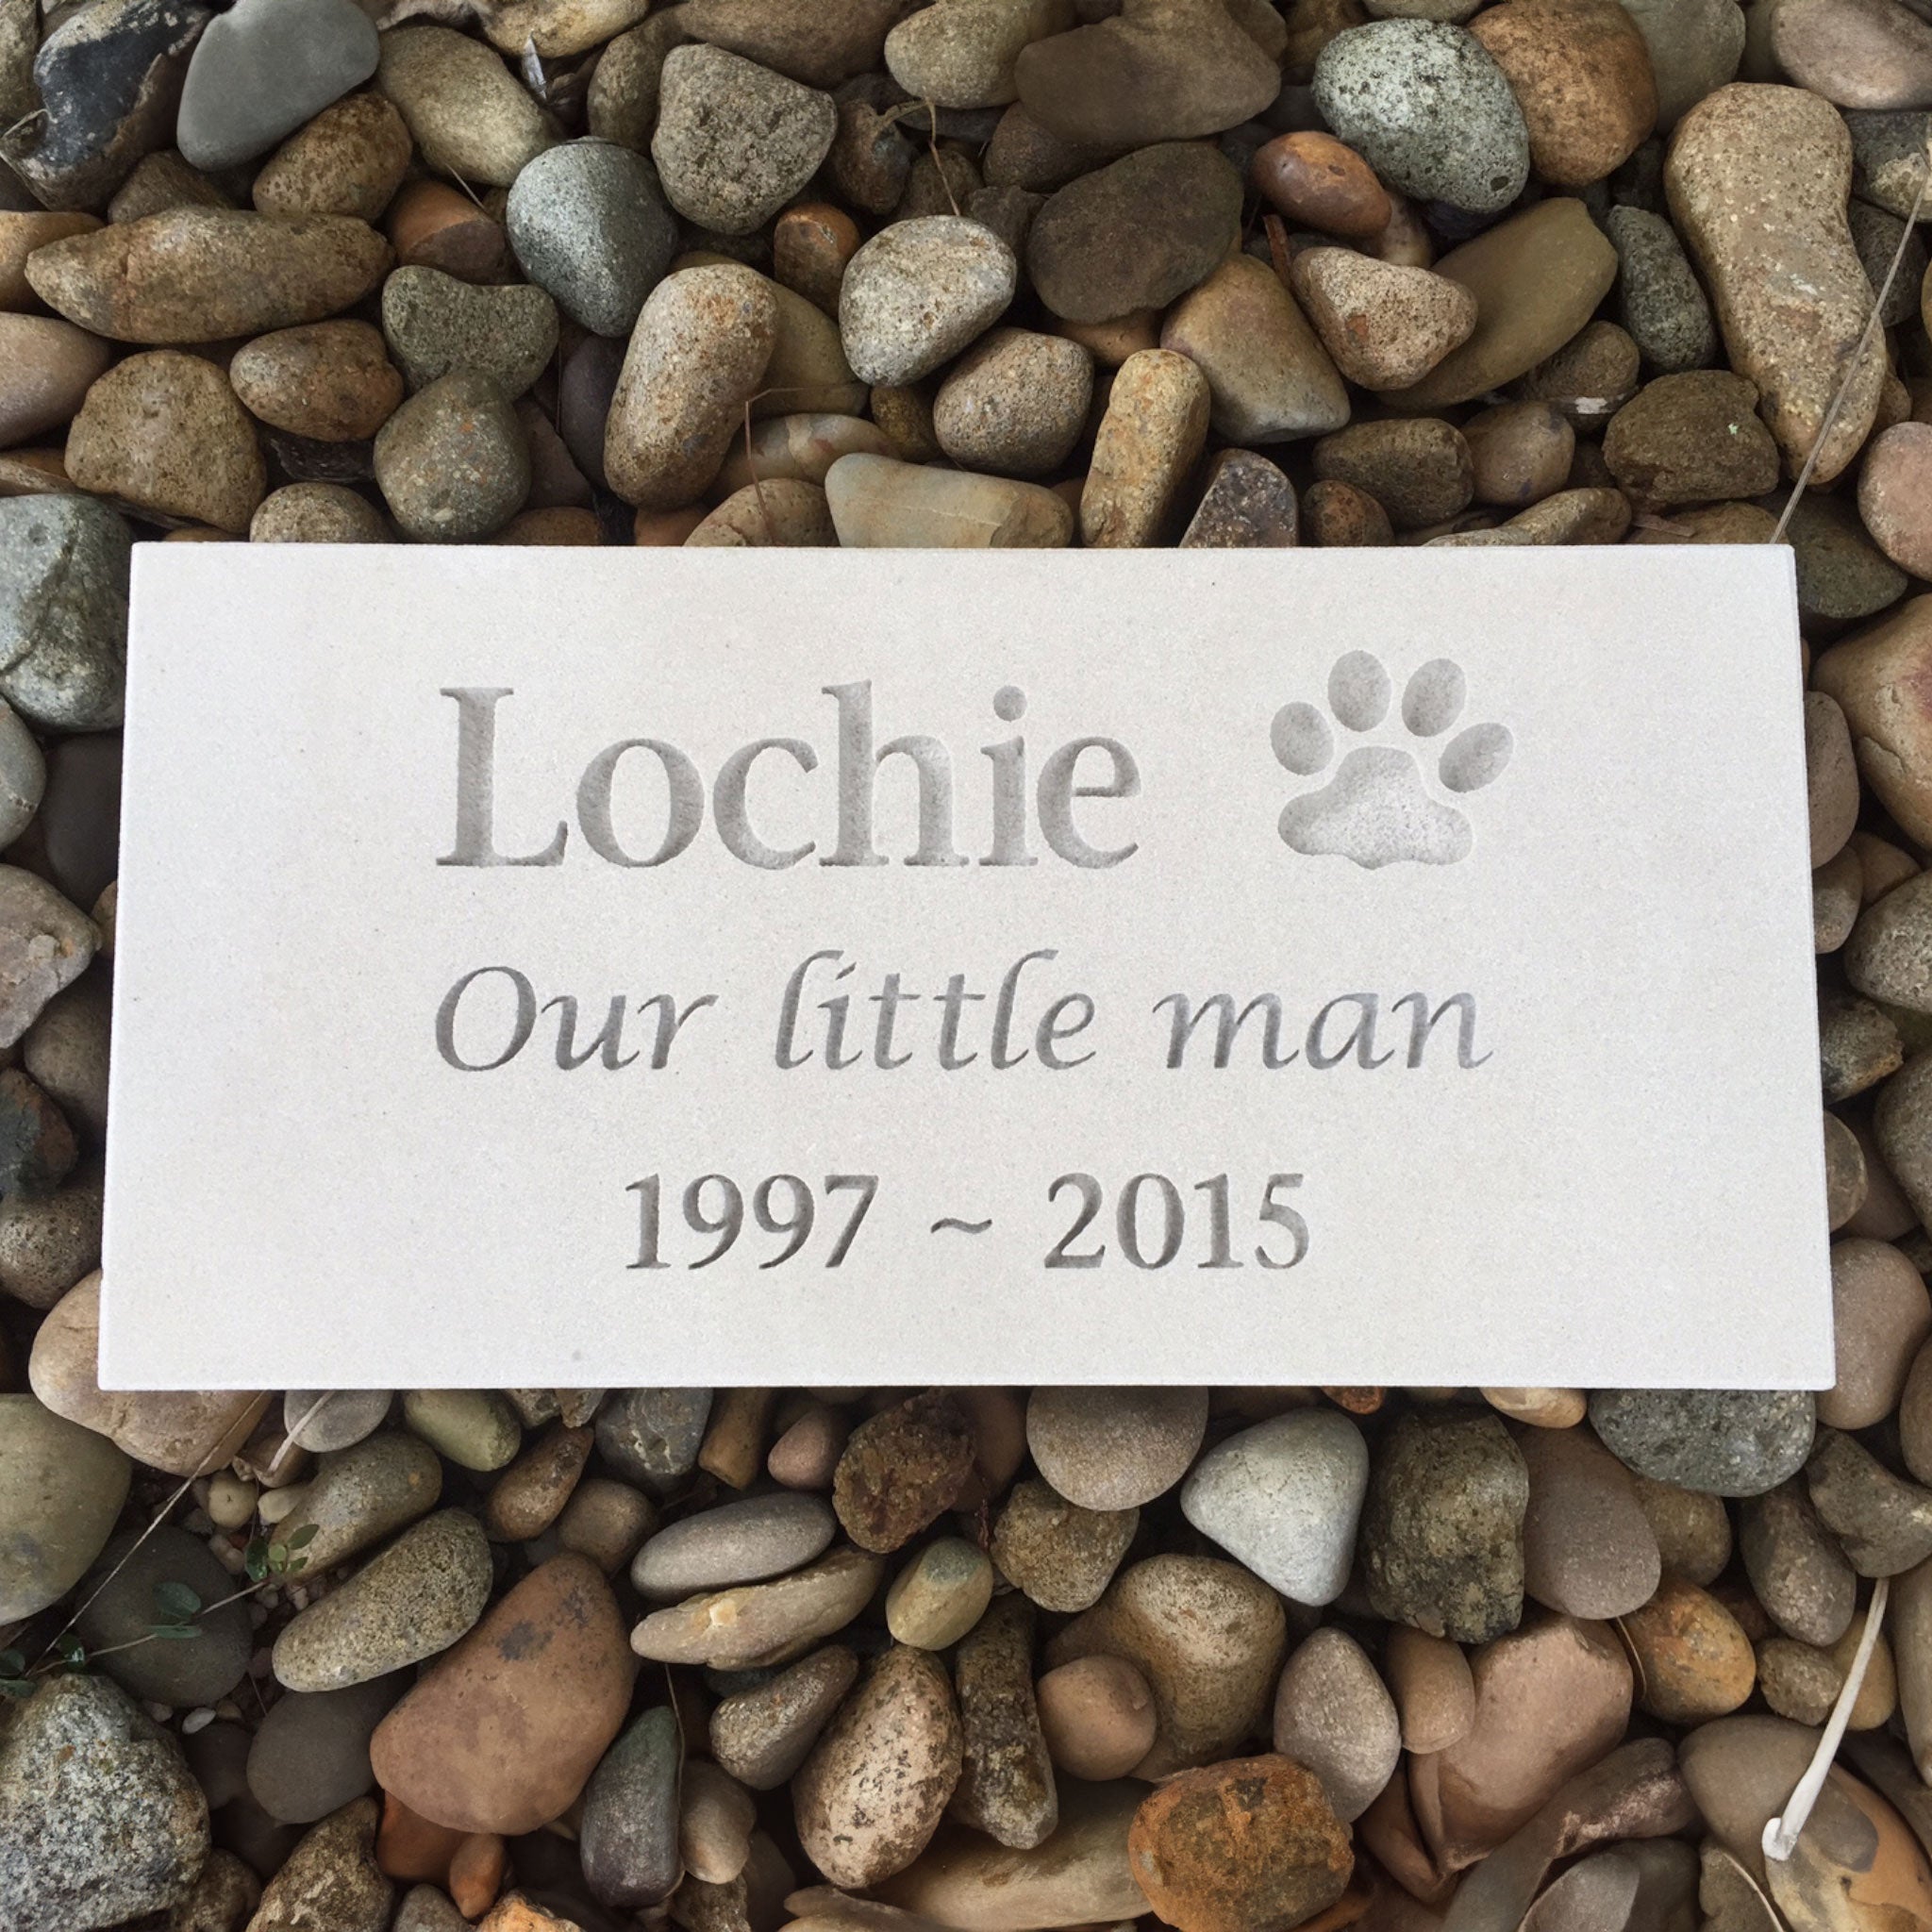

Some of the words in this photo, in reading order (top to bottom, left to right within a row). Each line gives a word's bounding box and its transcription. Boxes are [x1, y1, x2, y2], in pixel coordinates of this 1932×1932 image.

[436, 679, 1142, 869] Lochie
[436, 965, 717, 1072] Our
[774, 950, 1096, 1072] little
[1152, 991, 1493, 1071] man
[625, 1173, 879, 1271] 1997
[930, 1217, 992, 1236] ~
[1044, 1173, 1309, 1271] 2015
